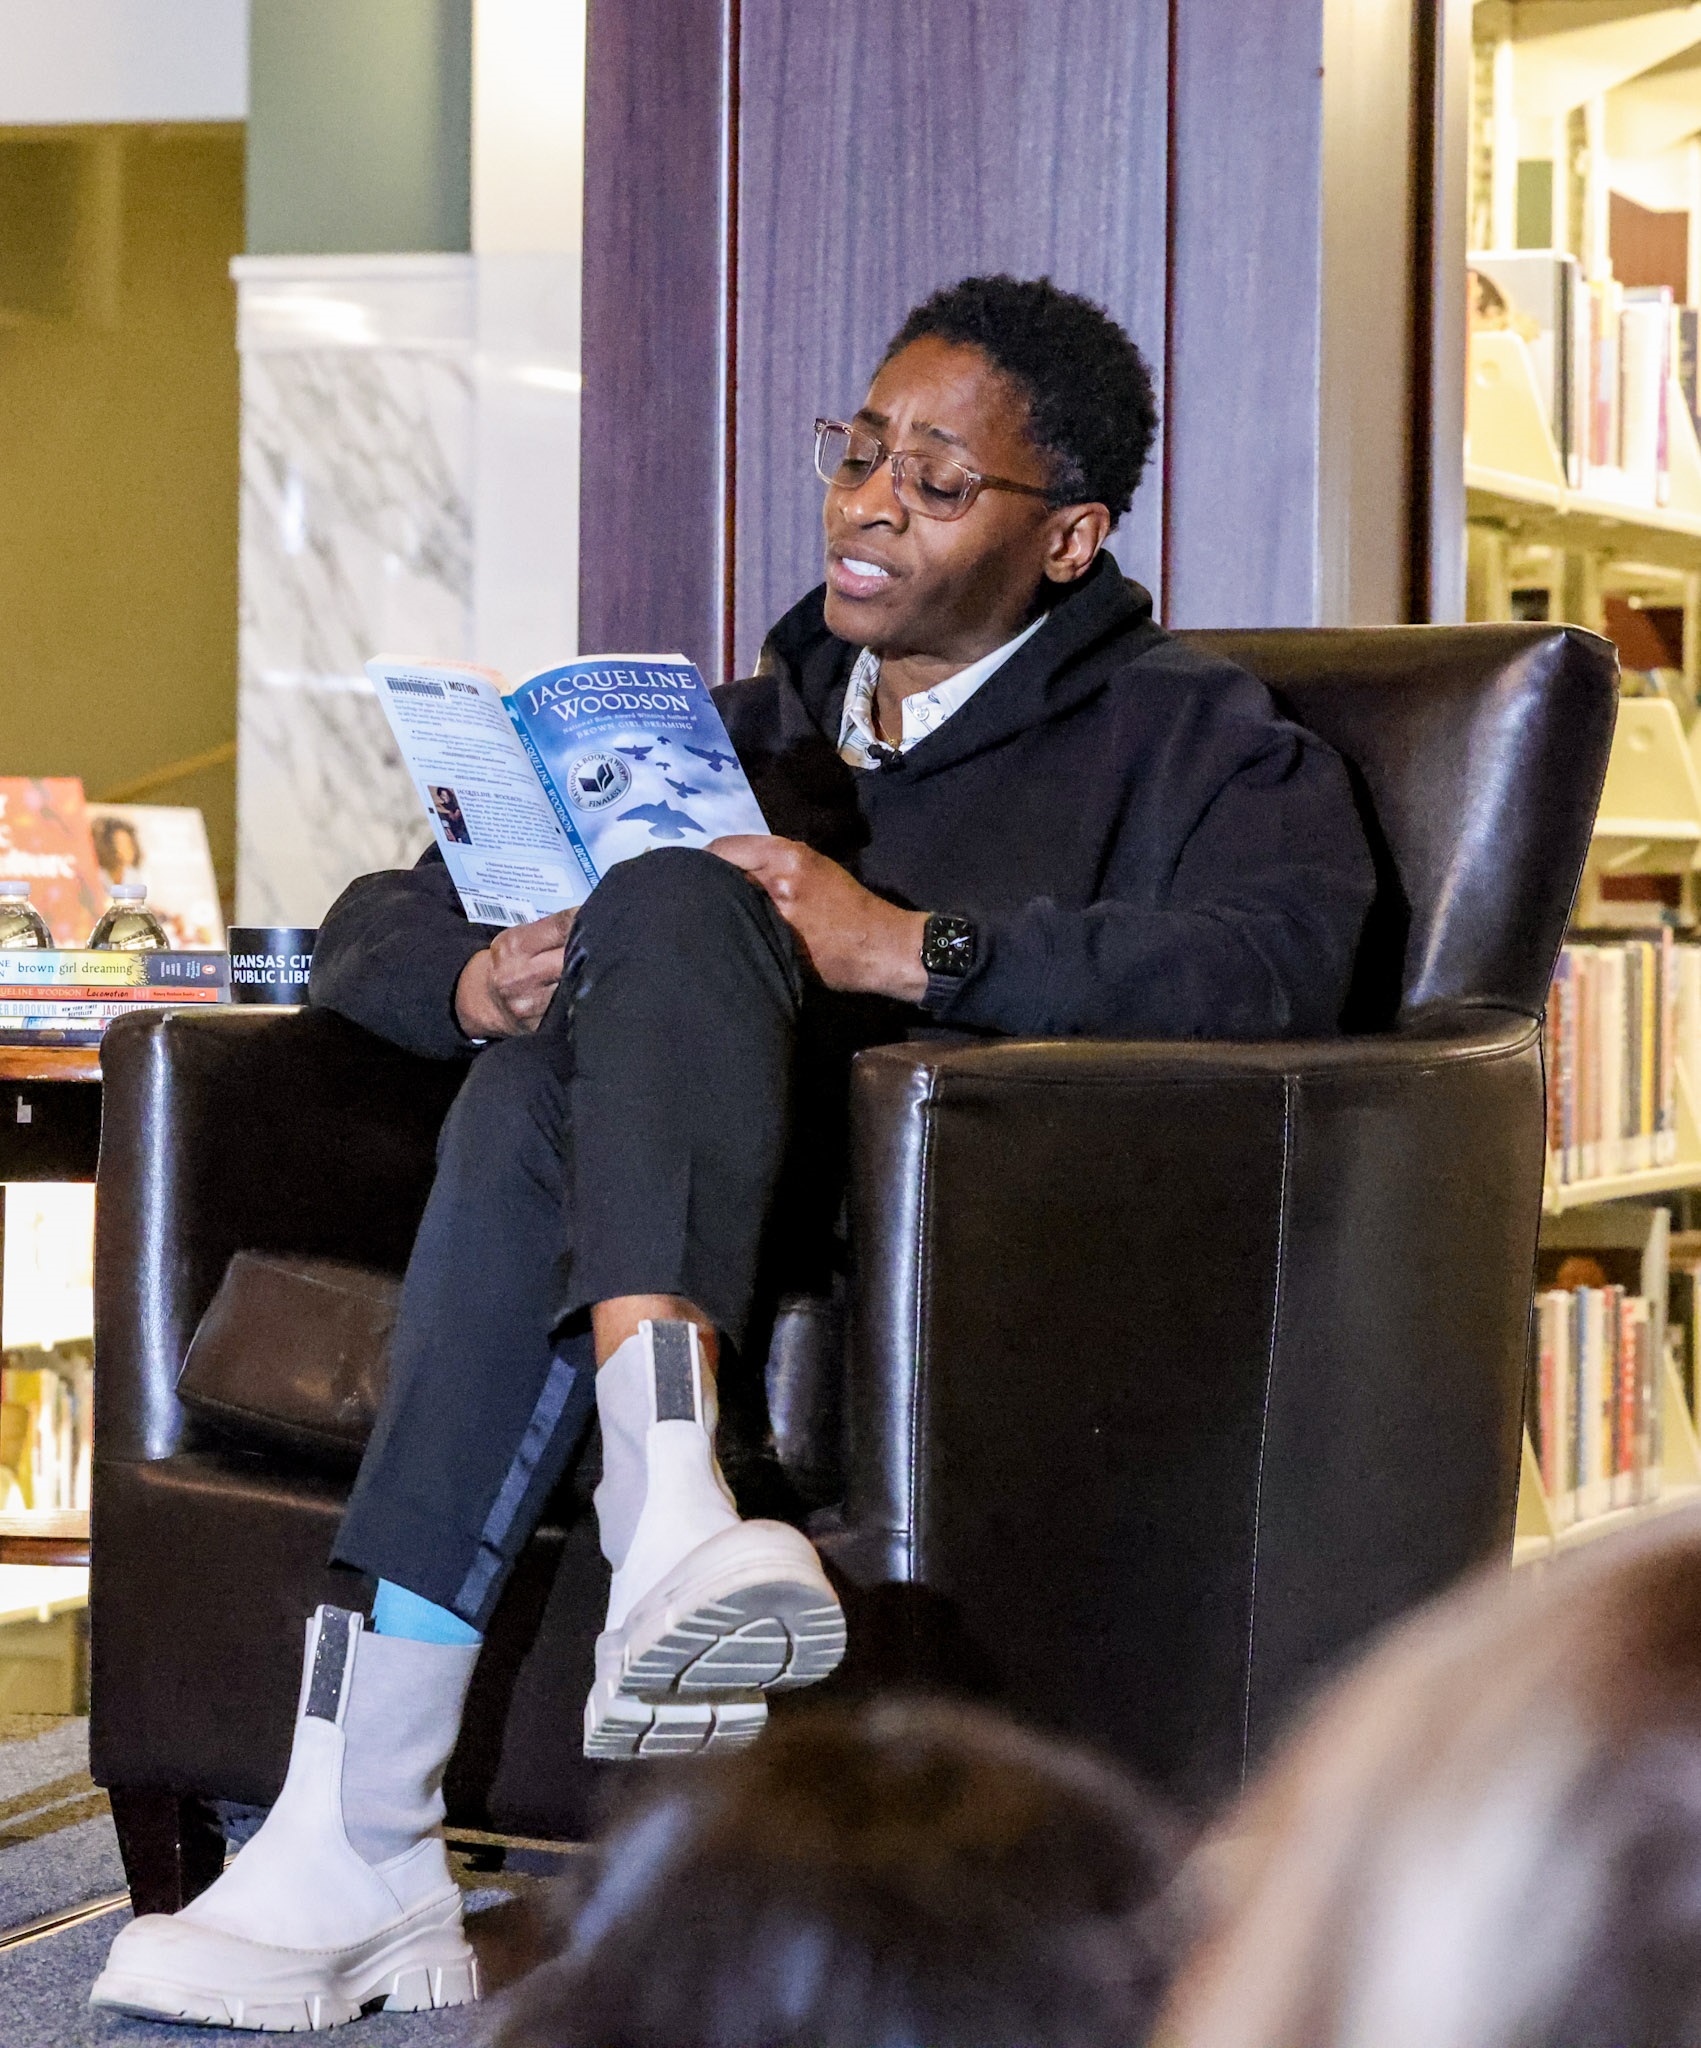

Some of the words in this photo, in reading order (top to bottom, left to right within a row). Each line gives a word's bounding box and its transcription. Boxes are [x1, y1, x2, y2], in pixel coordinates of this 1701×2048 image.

[444, 680, 480, 696] MOTION
[527, 670, 697, 715] JACQUELINE
[550, 693, 690, 721] WOODSON
[562, 718, 594, 735] National
[576, 722, 615, 739] BROWN
[618, 721, 641, 729] GIRL
[643, 720, 693, 730] DREAMING
[519, 733, 551, 787] JACQUELINE
[547, 788, 574, 833] WOODSON
[570, 762, 583, 803] NATIONAL
[582, 754, 606, 764] BOOK
[608, 757, 629, 781] AWARD
[588, 787, 622, 808] FINALIST
[18, 962, 55, 973] brown
[59, 962, 77, 975] girl
[81, 962, 133, 975] dreaming
[233, 954, 286, 968] KANSAS
[289, 954, 313, 969] CIT
[233, 970, 276, 984] PUBLIC
[0, 988, 33, 997] UELINE
[37, 988, 82, 997] WOODSON
[86, 988, 129, 997] Locomotion
[13, 1003, 57, 1016] BROOKLYN
